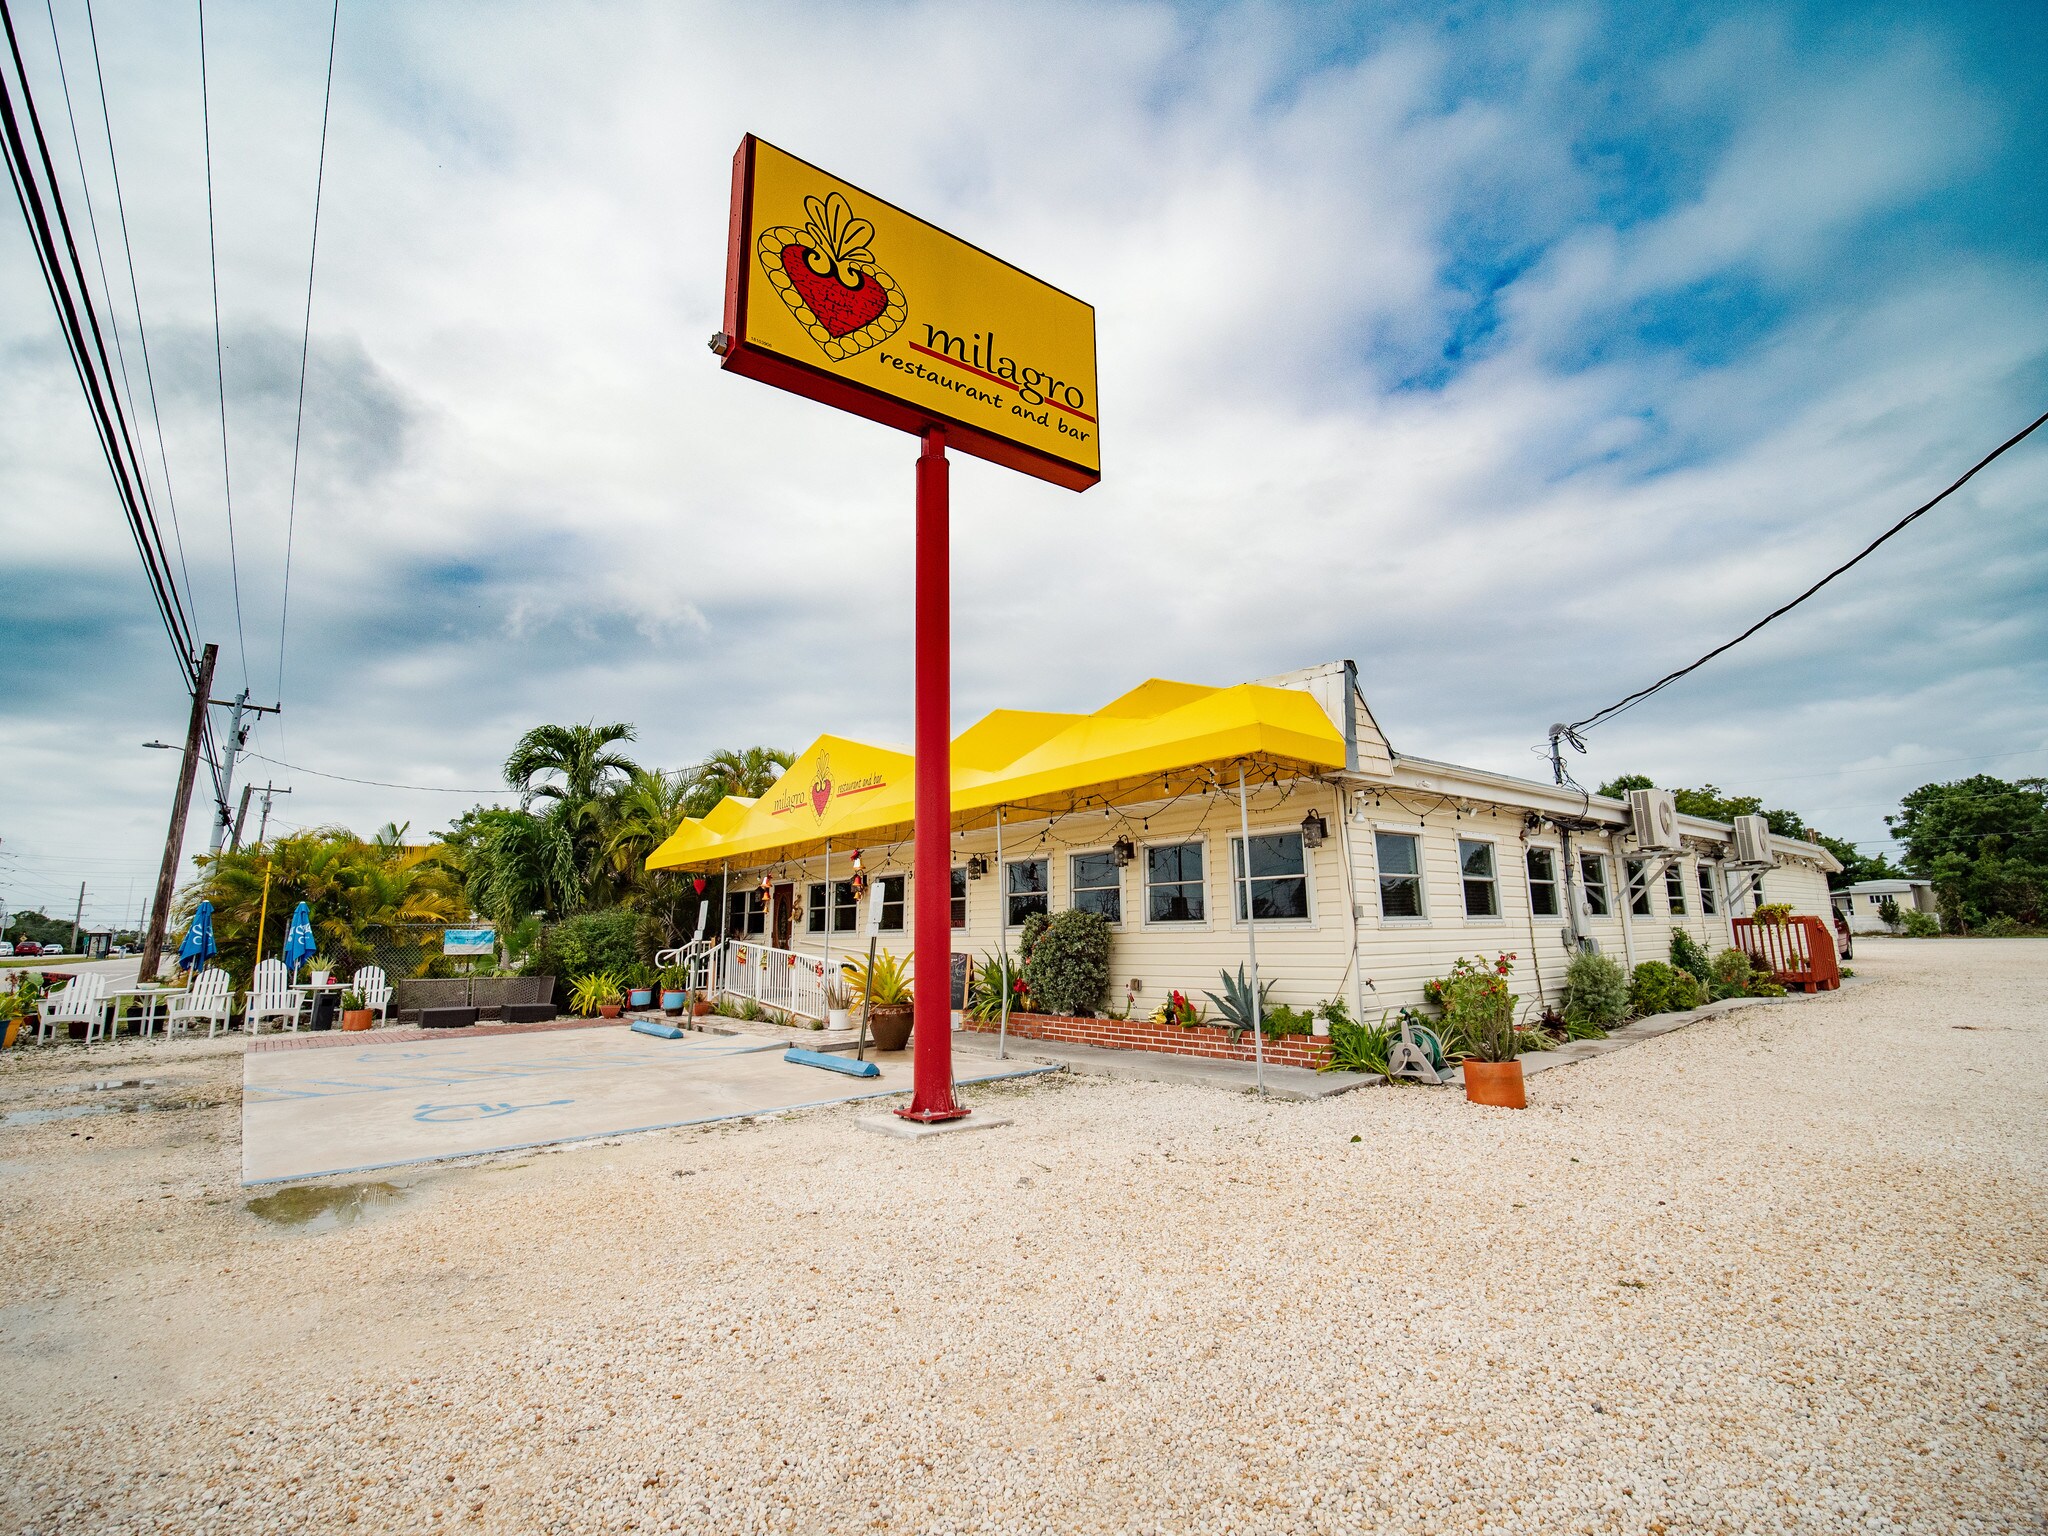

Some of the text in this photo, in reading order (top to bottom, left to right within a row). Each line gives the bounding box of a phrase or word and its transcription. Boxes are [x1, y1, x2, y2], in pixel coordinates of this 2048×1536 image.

[922, 322, 1085, 409] milagro
[880, 351, 1091, 442] restaurant and bar
[774, 788, 805, 814] milagro
[837, 771, 882, 793] restaurant and bar
